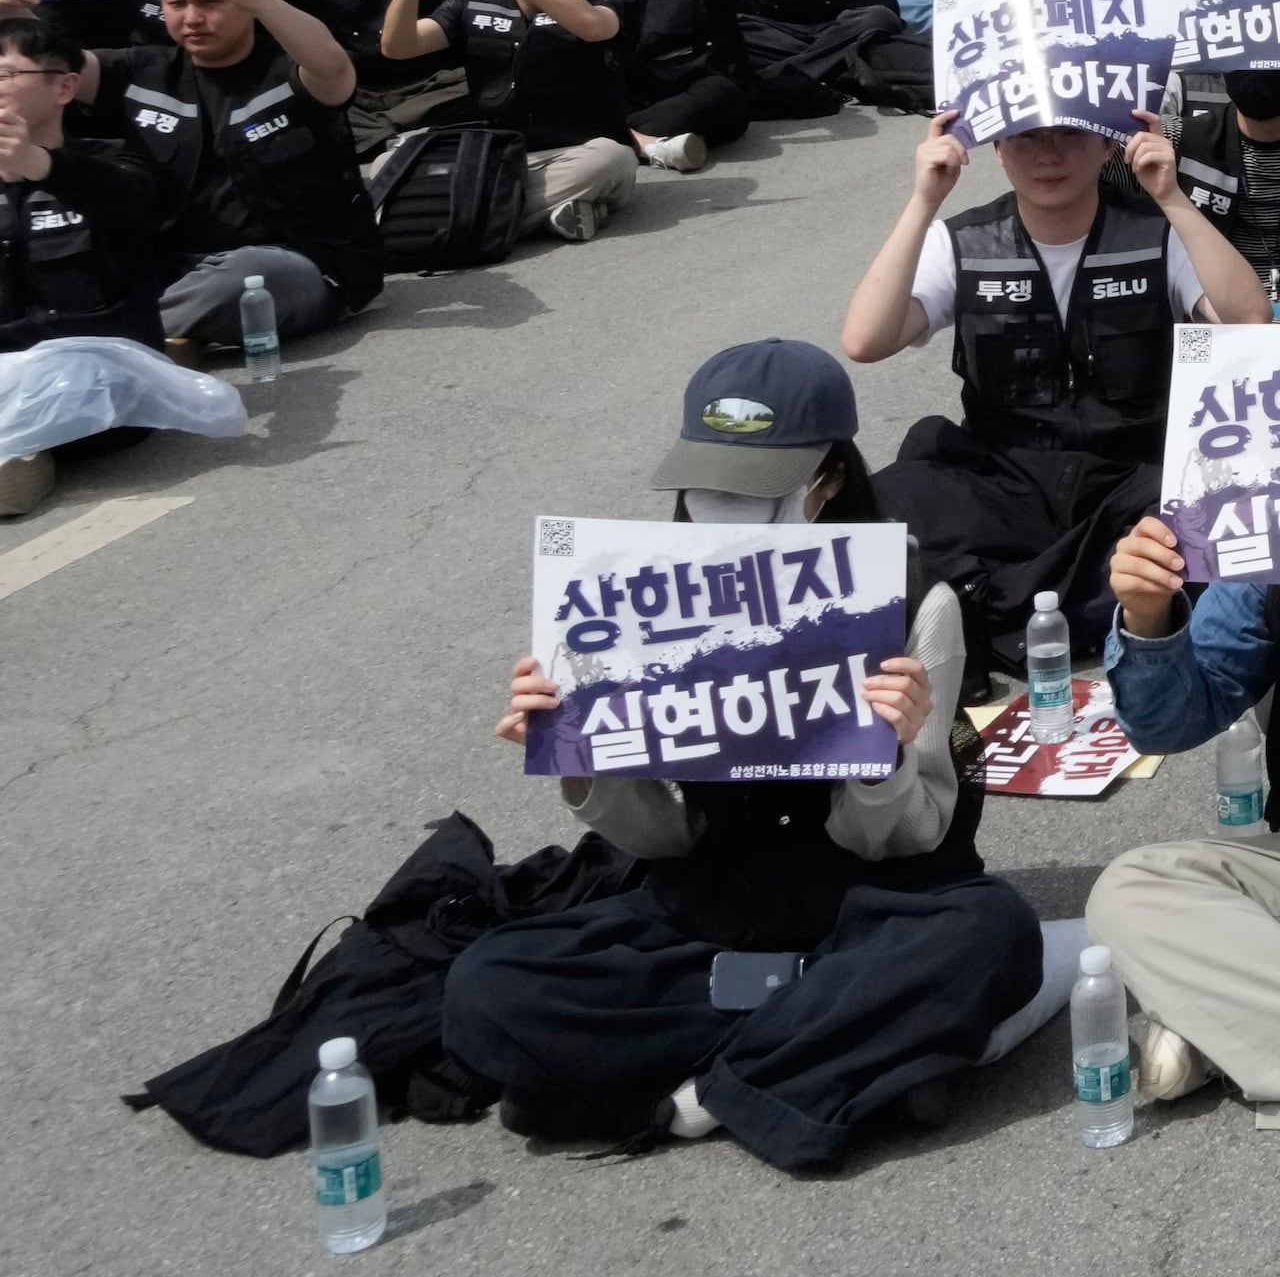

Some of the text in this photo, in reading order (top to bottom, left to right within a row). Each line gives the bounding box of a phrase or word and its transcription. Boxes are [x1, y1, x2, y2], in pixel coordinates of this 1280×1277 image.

[474, 13, 513, 33] 투쟁
[964, 62, 1164, 142] 실현하자
[135, 109, 179, 134] 투쟁
[244, 114, 289, 143] SELU
[1190, 186, 1231, 215] 투쟁
[31, 210, 83, 231] SELU
[976, 279, 1032, 303] 투쟁
[1092, 277, 1148, 300] SELU
[555, 537, 854, 654] 상한폐지
[580, 654, 877, 772] 실현하자
[730, 762, 892, 778] 삼성전자노동조합 공동투쟁본부
